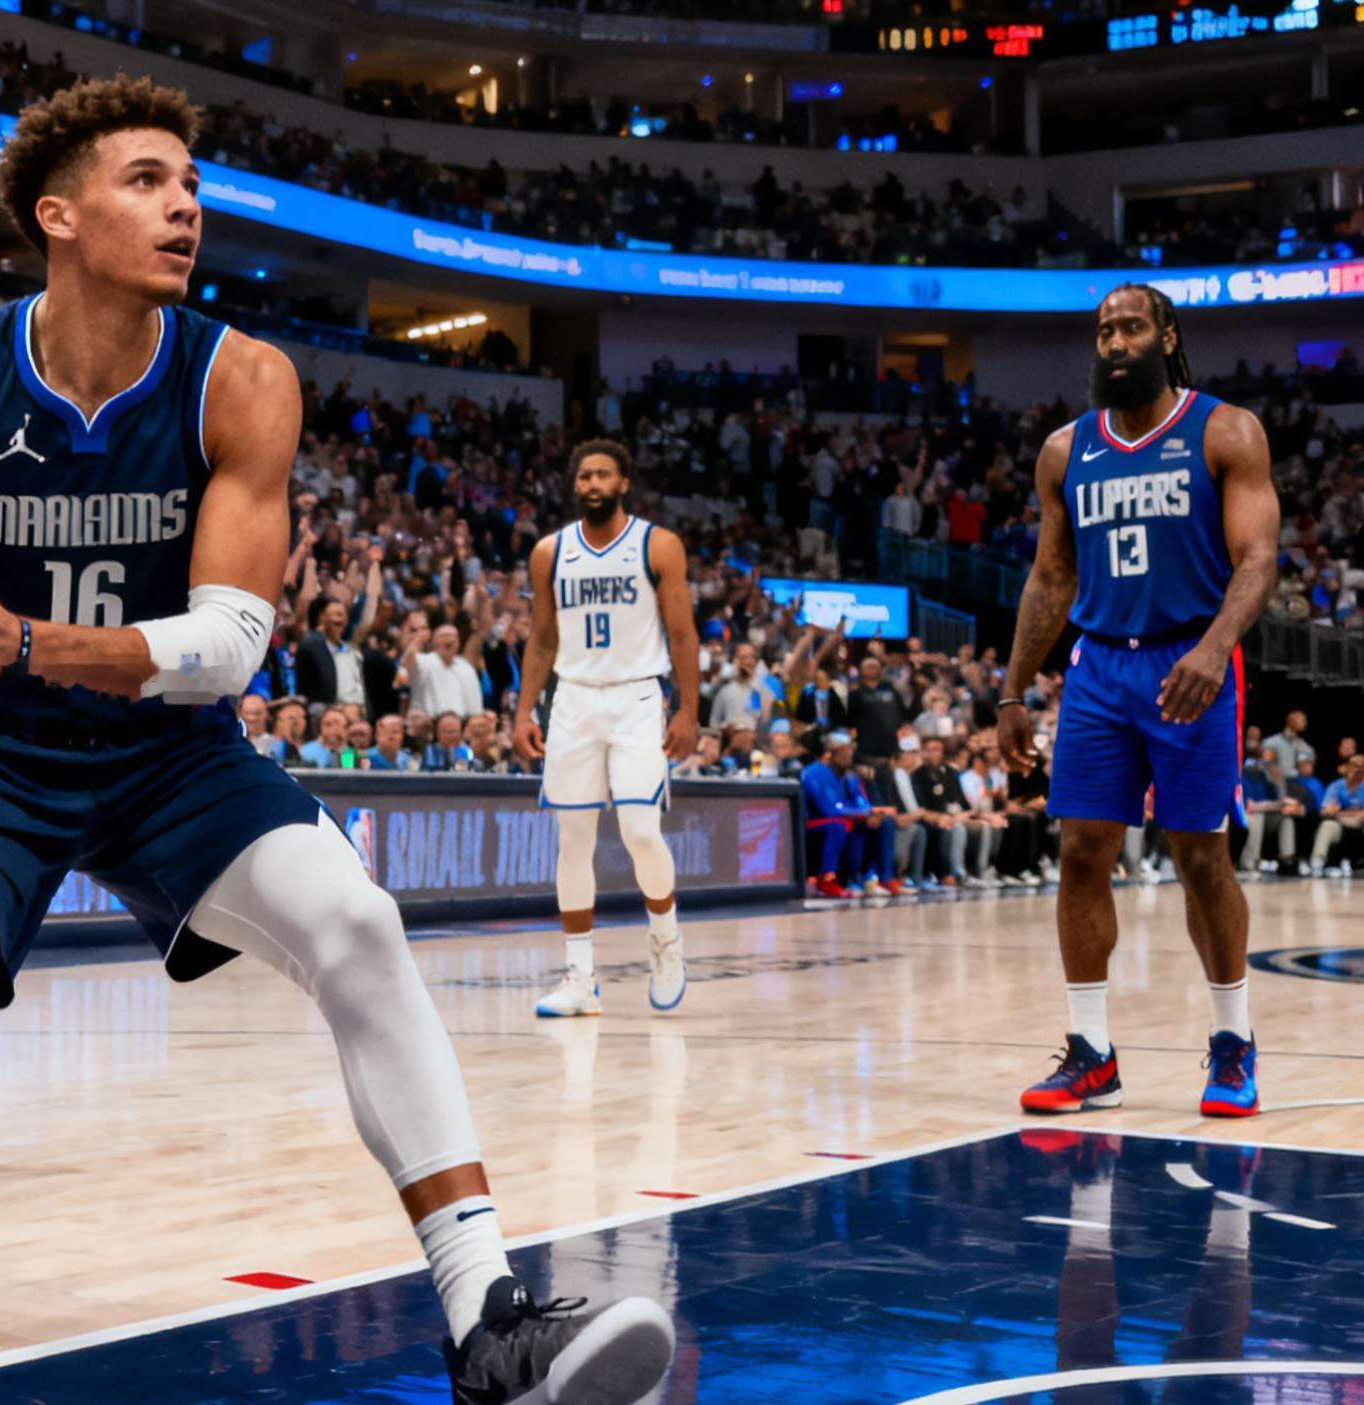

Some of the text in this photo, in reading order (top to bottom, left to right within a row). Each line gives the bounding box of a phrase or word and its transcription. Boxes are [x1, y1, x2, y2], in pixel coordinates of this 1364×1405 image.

[1107, 524, 1149, 578] 13
[43, 560, 126, 628] 16
[585, 612, 611, 649] 19
